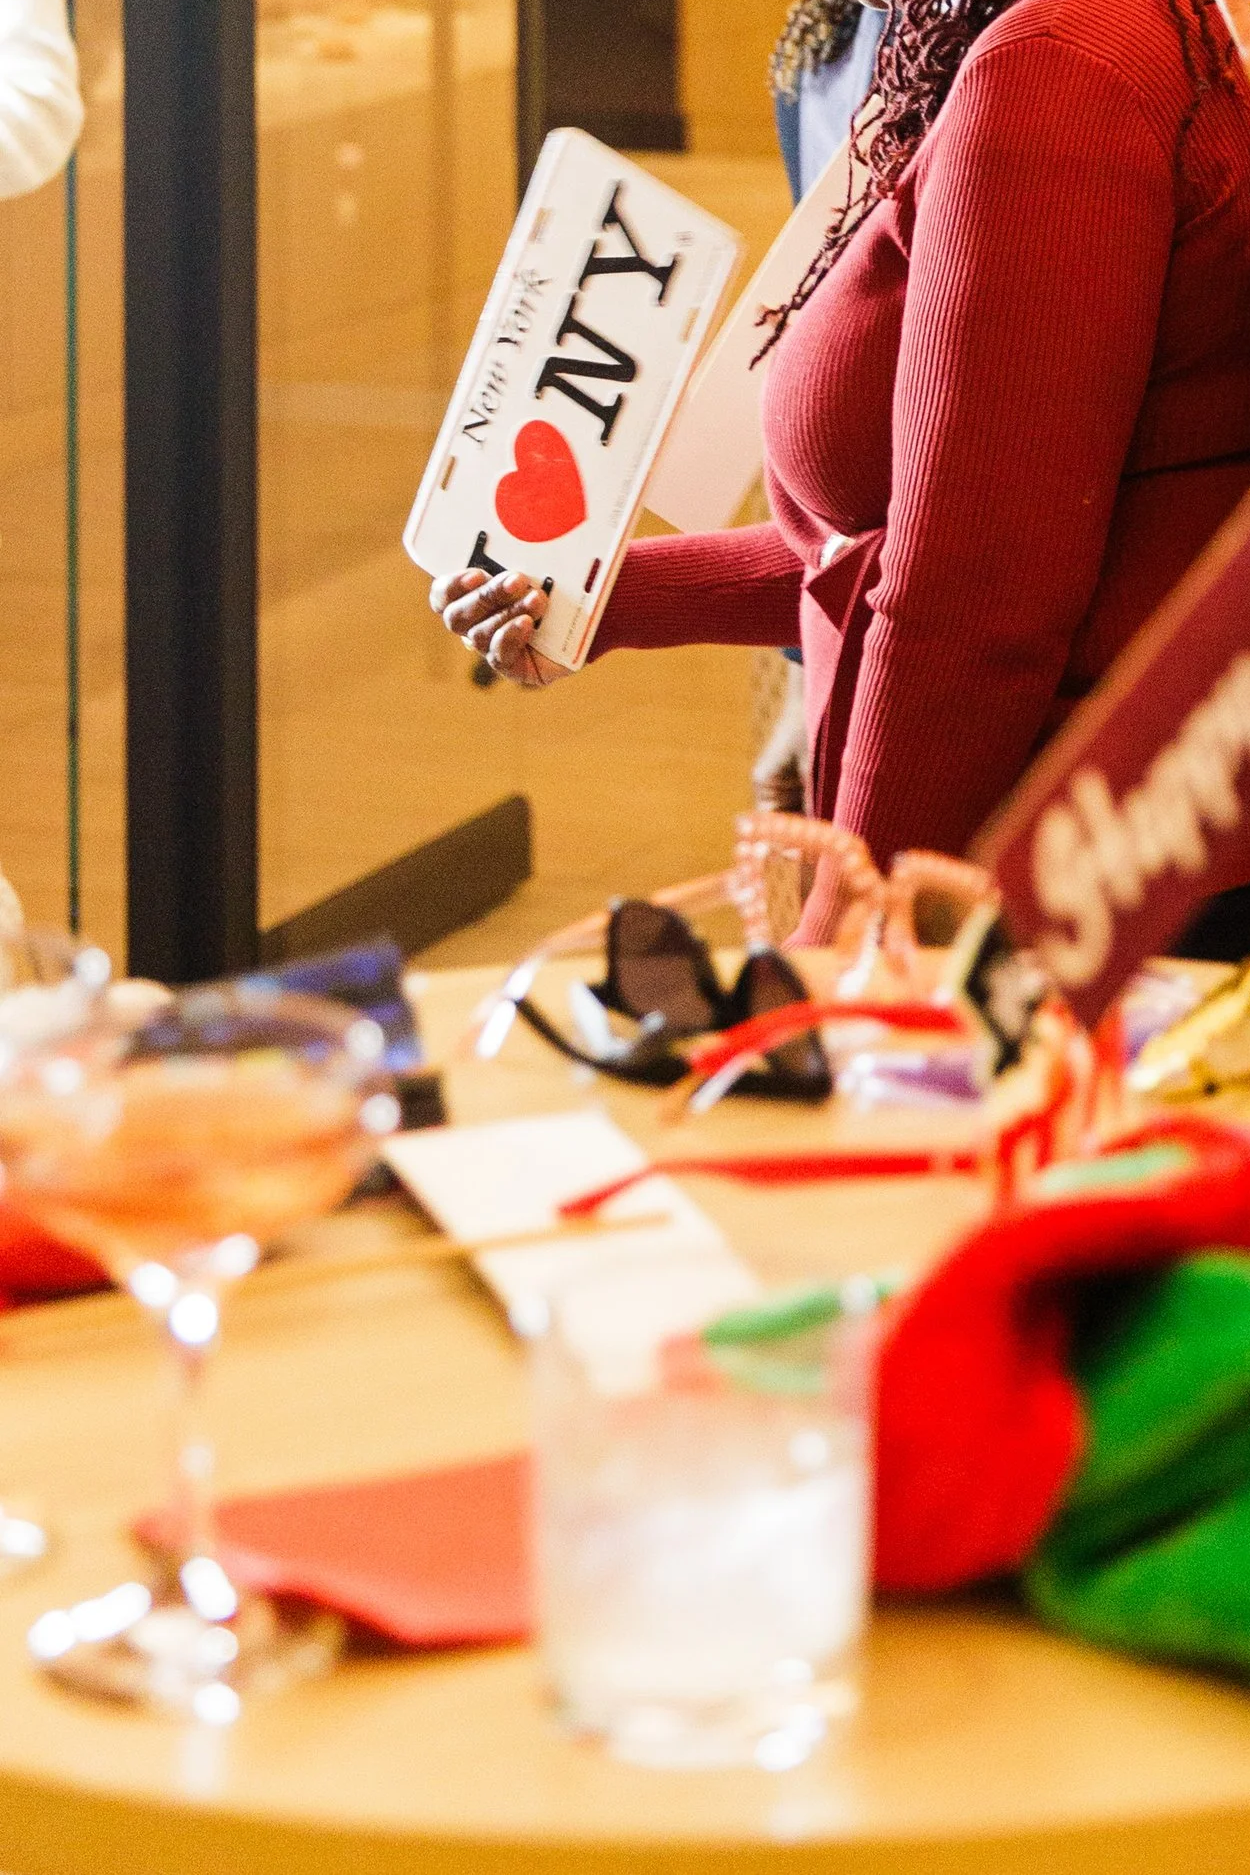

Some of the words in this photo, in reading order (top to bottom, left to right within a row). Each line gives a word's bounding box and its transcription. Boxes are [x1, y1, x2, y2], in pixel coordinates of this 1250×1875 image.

[462, 361, 507, 450] New
[496, 268, 552, 348] York
[534, 178, 680, 448] NY
